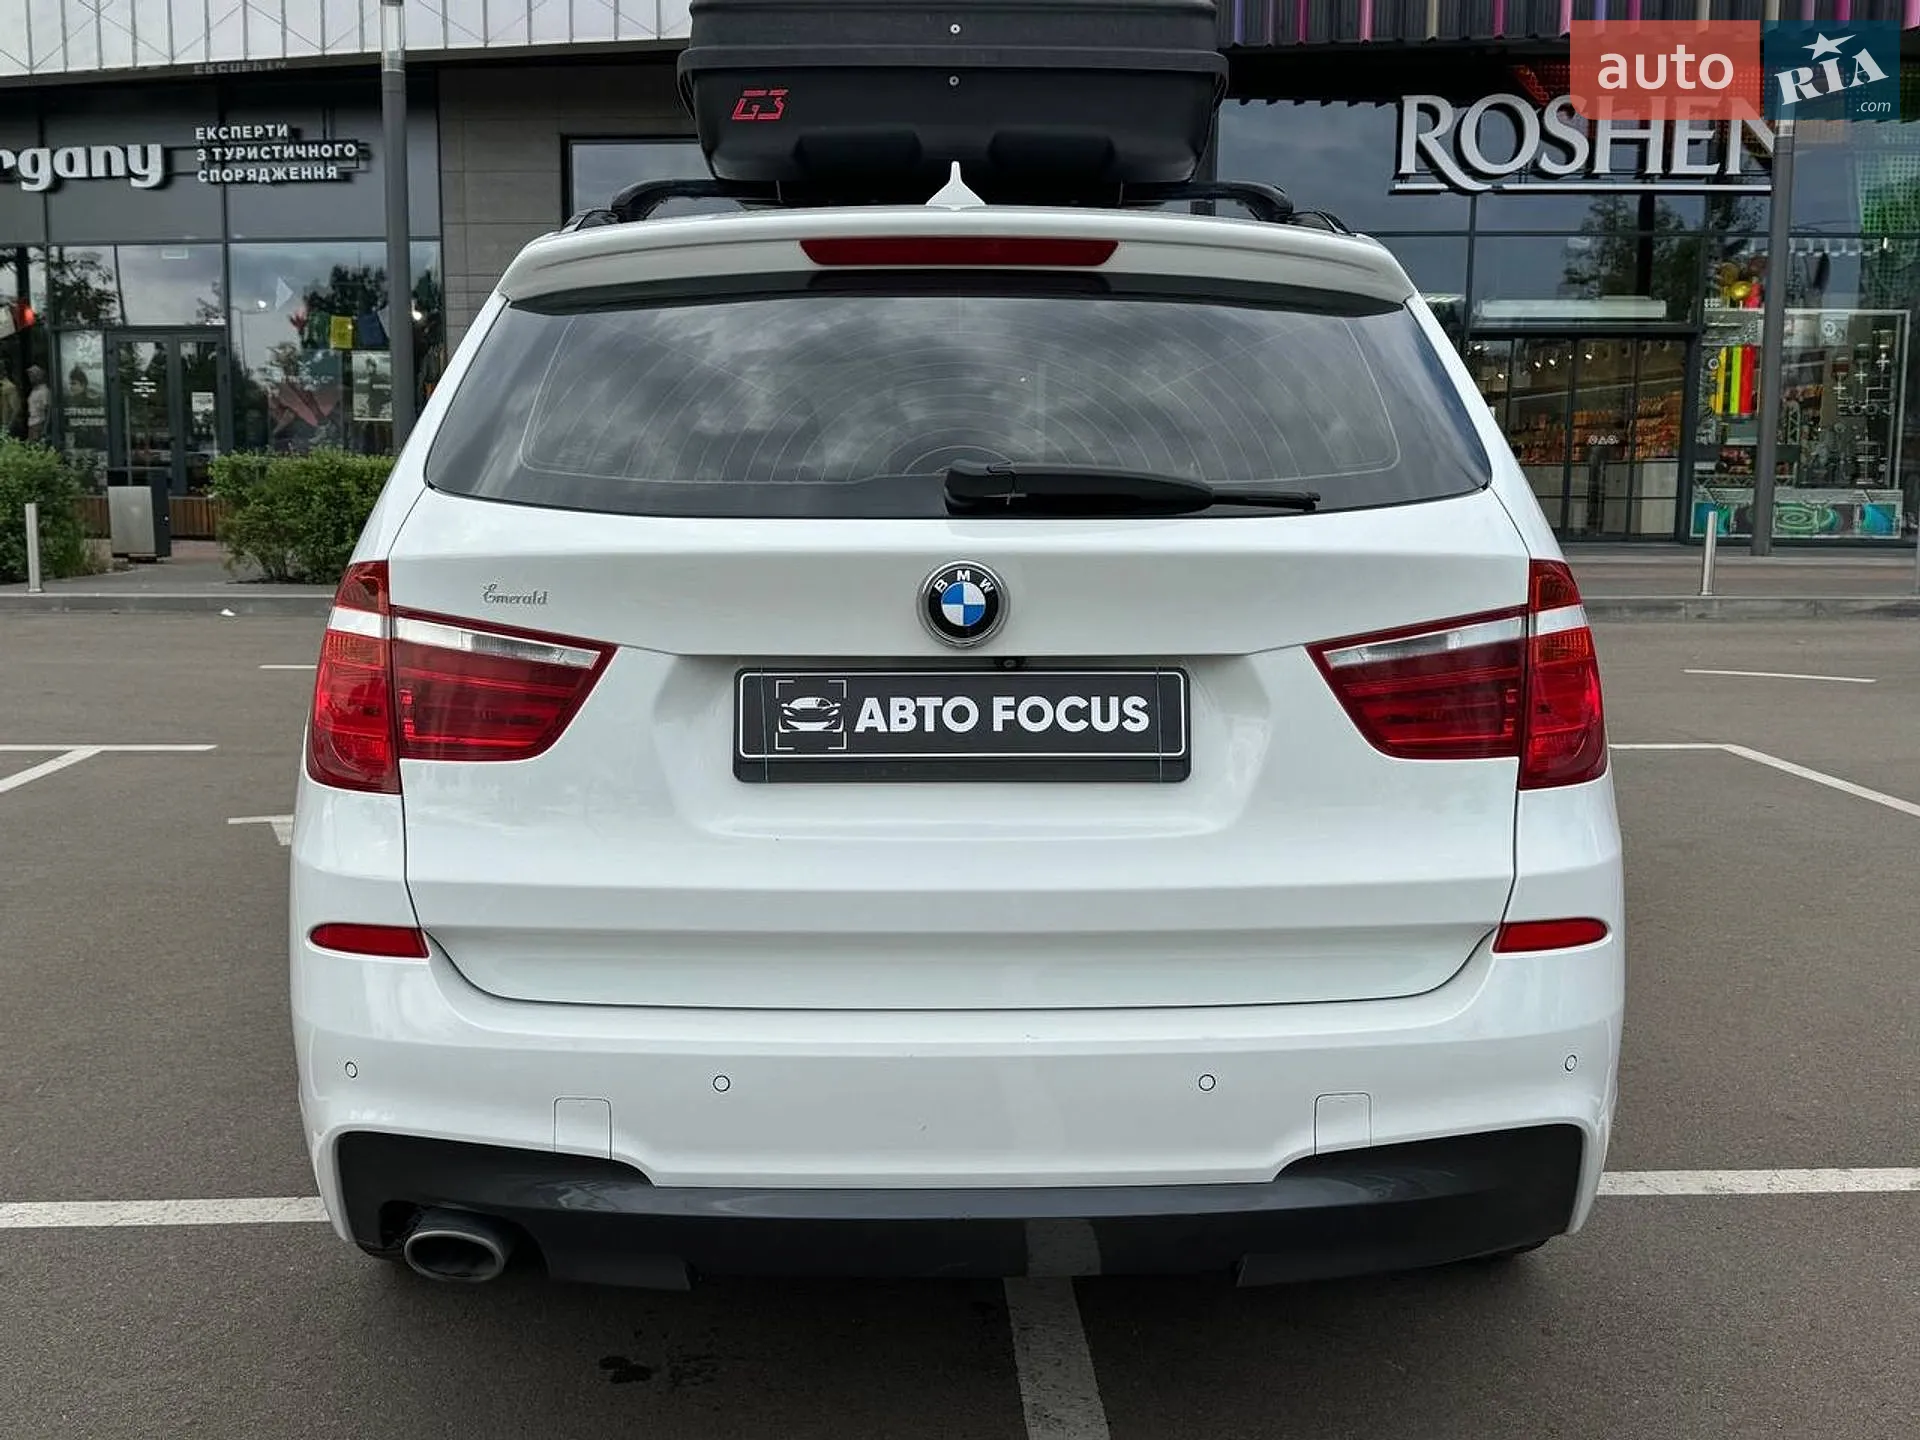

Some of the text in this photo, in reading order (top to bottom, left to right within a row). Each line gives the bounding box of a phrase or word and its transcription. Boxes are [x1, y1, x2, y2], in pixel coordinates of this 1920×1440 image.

[195, 124, 288, 140] ЕКСПЕРТИ
[212, 144, 358, 160] ТУРИСТИЧНОГО
[197, 166, 338, 182] СПОРЯДЖЕННЯ
[934, 570, 994, 593] BMW
[483, 584, 548, 604] Emerald
[992, 695, 1150, 733] FOCUS
